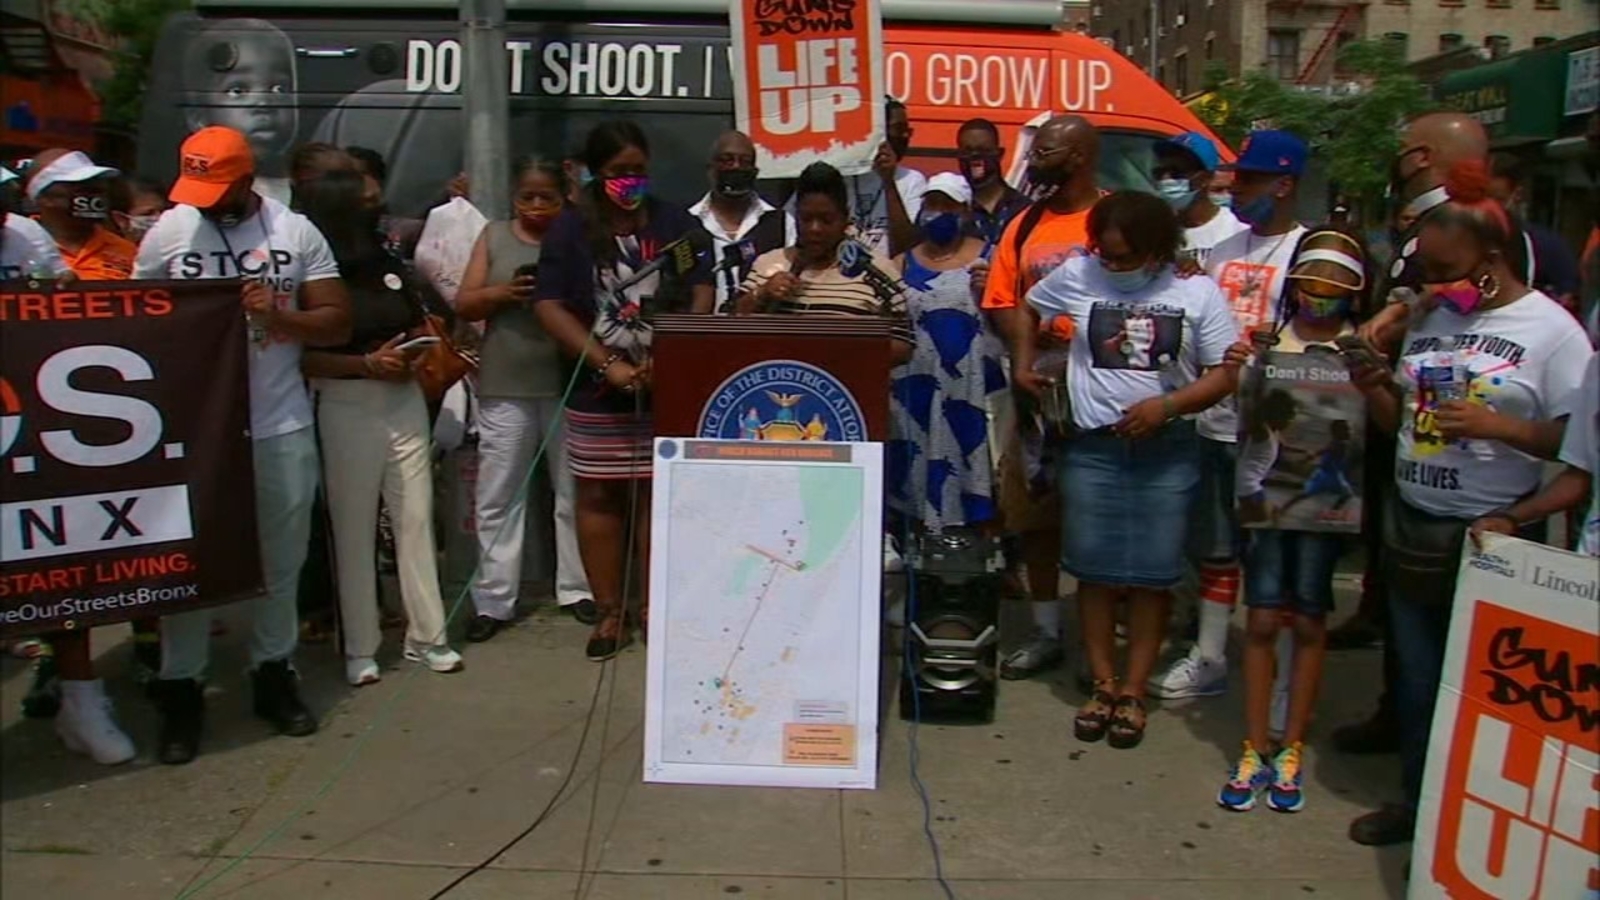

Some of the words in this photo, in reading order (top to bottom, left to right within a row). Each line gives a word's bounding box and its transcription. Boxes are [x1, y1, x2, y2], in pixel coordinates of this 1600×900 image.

[541, 43, 689, 96] SHOOT.
[926, 53, 1047, 110] GROW
[1060, 58, 1114, 112] UP.
[758, 37, 858, 88] LIFE
[760, 86, 861, 135] UP
[181, 249, 292, 278] STOP
[717, 387, 736, 408] OF
[734, 370, 766, 392] THE
[767, 366, 838, 397] DISTRICT
[1309, 367, 1351, 382] Shoo
[0, 566, 87, 597] START
[96, 552, 197, 584] LIVING.
[1532, 566, 1600, 601] Lincol
